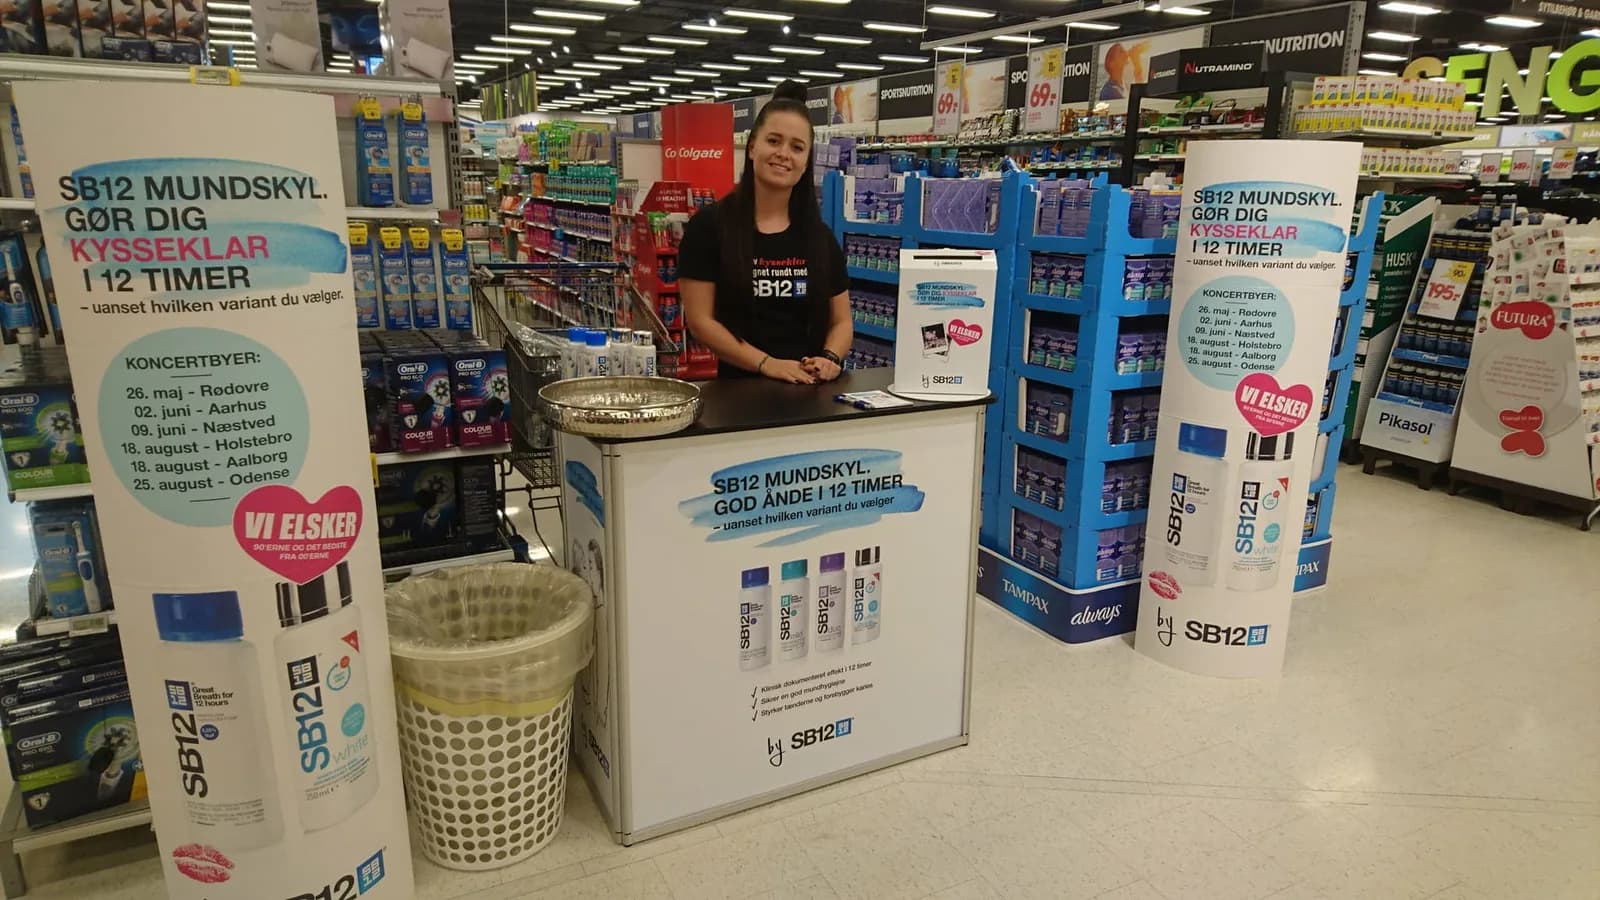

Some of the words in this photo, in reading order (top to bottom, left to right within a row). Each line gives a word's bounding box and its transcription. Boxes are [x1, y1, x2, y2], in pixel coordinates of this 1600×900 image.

[1263, 30, 1344, 54] NUTRITION
[881, 84, 934, 100] SPORTSNUTRITION
[679, 147, 722, 161] Colgate
[59, 176, 135, 202] SB12
[144, 176, 328, 202] MUNDSKYL.
[1193, 190, 1233, 205] SB12
[1238, 191, 1343, 207] MUNDSKYL.
[65, 206, 133, 233] GØR
[145, 206, 207, 232] DIG
[1191, 207, 1228, 221] GØR
[1235, 208, 1267, 223] DIG
[1189, 223, 1298, 240] KYSSEKLAR
[70, 235, 270, 263] KYSSEKLAR
[1192, 240, 1197, 253] I
[1202, 240, 1219, 254] 12
[1225, 241, 1283, 256] TIMER
[1192, 258, 1223, 267] uanset
[1225, 258, 1259, 269] hvilken
[1262, 260, 1294, 270] variant
[1296, 260, 1308, 270] du
[1309, 262, 1337, 272] vælger.
[1386, 252, 1413, 268] HUSK
[83, 268, 92, 293] I
[105, 268, 134, 293] 12
[141, 265, 251, 293] TIMER
[771, 267, 792, 277] rundt
[92, 300, 146, 315] uanset
[151, 298, 213, 315] hvilken
[219, 294, 277, 311] variant
[280, 292, 299, 307] du
[303, 288, 344, 306] vælger.
[1203, 289, 1277, 301] KONCERTBYER:
[1198, 305, 1211, 315] 26.
[1213, 307, 1230, 317] maj
[1239, 308, 1277, 318] Rødovre
[1496, 310, 1548, 328] FUTURA
[1195, 326, 1208, 335] 09.
[1209, 327, 1226, 338] juni
[1234, 328, 1275, 339] Næstved
[1199, 316, 1212, 325] 02.
[1214, 317, 1232, 328] juni
[1240, 319, 1273, 329] Aarhus
[1187, 336, 1198, 345] 18.
[1199, 337, 1229, 349] august
[1238, 340, 1282, 350] Holstebro
[125, 352, 261, 371] KONCERTBYER:
[458, 361, 483, 369] Oral-B
[1188, 356, 1201, 366] 25.
[1201, 358, 1232, 370] august
[1240, 361, 1275, 371] Odense
[1189, 347, 1200, 356] 18.
[1202, 348, 1232, 359] august
[1240, 350, 1277, 362] Aalborg
[400, 364, 425, 373] Oral-B
[932, 375, 954, 384] SB12
[1, 395, 35, 405] Oral-B
[126, 386, 148, 400] 26.
[153, 386, 183, 402] maj
[200, 381, 270, 399] Rødovre
[1240, 384, 1260, 405] VI
[1258, 391, 1308, 420] ELSKER
[134, 405, 158, 419] 02.
[160, 404, 191, 420] juni
[208, 398, 267, 415] Aarhus
[131, 424, 154, 437] 09.
[157, 423, 187, 439] juni
[203, 415, 276, 434] Næstved
[463, 425, 492, 434] COLOUR
[1378, 412, 1433, 436] Pikasol
[121, 442, 141, 455] 18.
[144, 442, 199, 458] august
[215, 430, 293, 453] Holstebro
[405, 430, 433, 440] COLOUR
[130, 461, 151, 474] 18.
[155, 460, 209, 476] august
[226, 450, 288, 470] Aalborg
[15, 469, 53, 479] COLOUR
[133, 479, 155, 492] 25.
[159, 478, 213, 494] august
[230, 467, 291, 487] Odense
[712, 473, 760, 495] SB12
[765, 460, 871, 488] MUNDSKYL.
[714, 495, 757, 516] GOD
[762, 488, 812, 509] ÅNDE
[818, 487, 823, 502] I
[830, 483, 847, 500] 12
[850, 474, 903, 495] TIMER
[723, 515, 763, 533] uanset
[765, 509, 803, 527] hvilken
[806, 503, 842, 520] variant
[844, 501, 858, 514] du
[860, 495, 895, 511] vælger
[1167, 492, 1185, 546] SB12
[245, 511, 276, 540] VI
[279, 511, 357, 540] ELSKER
[1235, 500, 1258, 554] SB12
[279, 553, 297, 561] FRA
[306, 543, 322, 551] DET
[1296, 561, 1320, 576] PAX
[854, 589, 865, 622] SB12
[1002, 578, 1049, 615] TAMPAX
[780, 606, 791, 641] SB12
[818, 598, 829, 635] SB12
[1070, 603, 1123, 626] always
[740, 614, 750, 650] SB12
[1158, 606, 1177, 646] by
[1184, 620, 1247, 646] SB12
[761, 683, 782, 694] Klinisk
[783, 671, 826, 688] dokumenteret
[827, 667, 844, 677] effekt
[848, 663, 856, 671] 12
[857, 661, 873, 670] timer
[192, 685, 214, 694] Great
[192, 692, 221, 701] Breath
[790, 689, 803, 699] god
[760, 704, 783, 717] Styrker
[814, 695, 823, 704] og
[21, 733, 56, 748] Oral-B
[293, 686, 331, 774] SB12
[171, 712, 209, 798] SB12
[331, 734, 369, 766] white
[767, 737, 786, 767] by
[791, 723, 835, 750] SB12
